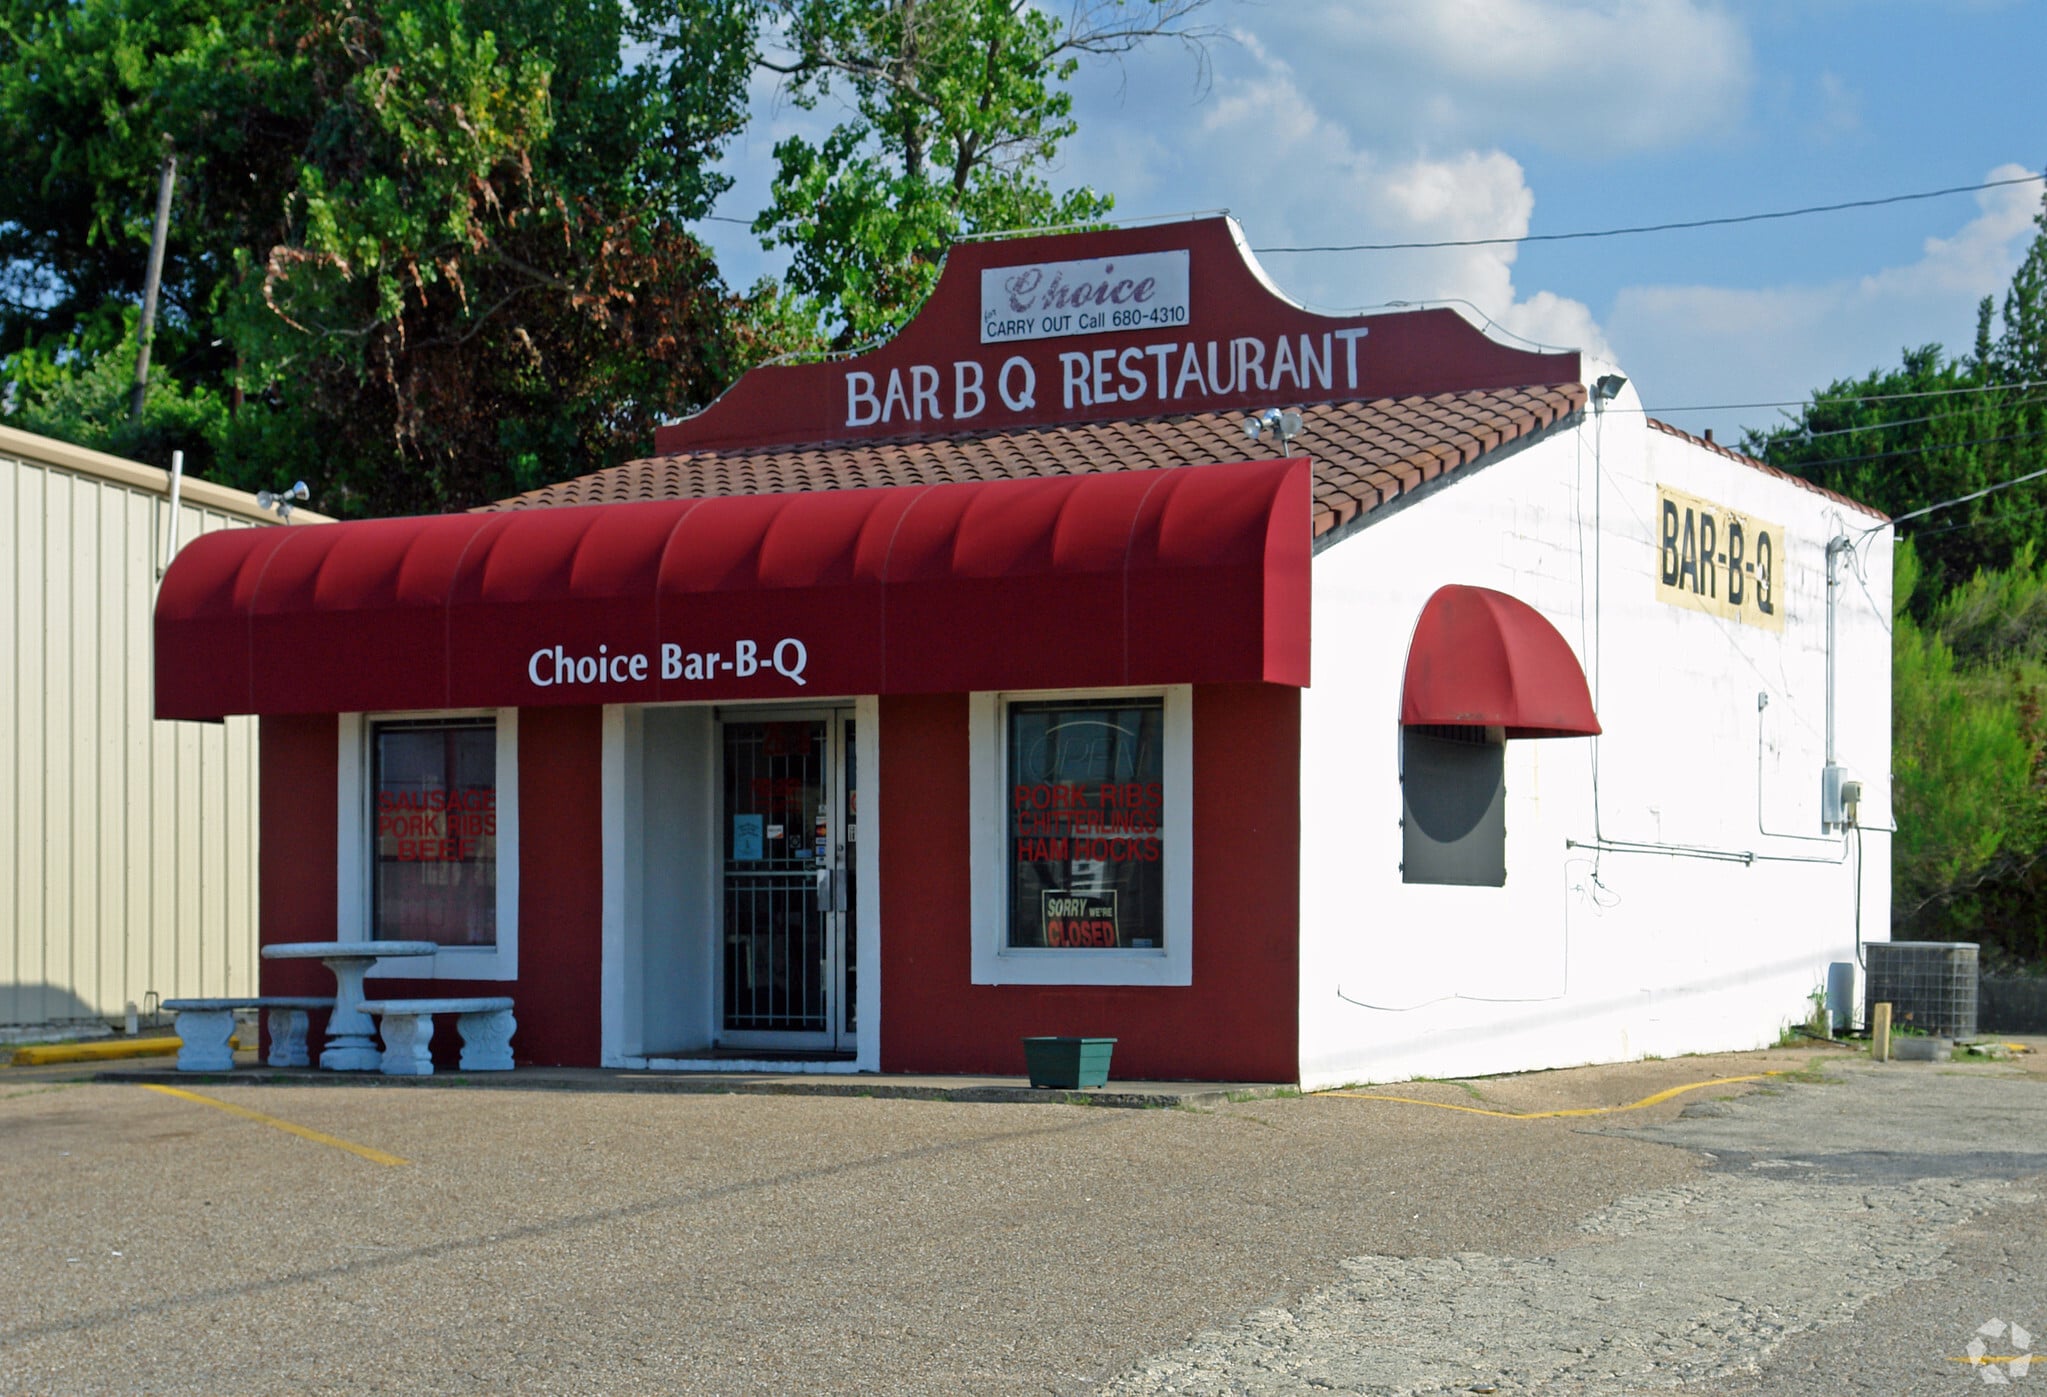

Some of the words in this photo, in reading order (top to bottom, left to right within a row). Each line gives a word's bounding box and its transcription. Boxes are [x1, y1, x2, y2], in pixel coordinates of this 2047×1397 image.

[1005, 263, 1156, 313] Choice
[987, 318, 1035, 338] CARRY
[1042, 315, 1072, 332] OUT
[1079, 312, 1105, 329] Call
[1112, 305, 1185, 327] 680-4310
[845, 364, 944, 428] BAR
[998, 355, 1036, 413] Q
[1058, 326, 1369, 409] RESTAURANT
[1662, 497, 1774, 617] BAR-B-Q
[528, 644, 648, 687] Choice
[661, 638, 808, 686] Bar-B-Q
[377, 788, 497, 814] SAUSAGE
[1015, 784, 1089, 810] PORK
[1100, 782, 1163, 809] RIBS
[378, 814, 439, 838] PORK
[447, 813, 497, 837] RIBS
[1018, 809, 1158, 836] CHITTERLINGS
[397, 838, 476, 862] BEEF
[1017, 838, 1069, 862] HAM
[1074, 836, 1161, 862] HOCKS
[1047, 898, 1088, 918] SORRY
[1089, 906, 1113, 918] WE'RE
[1049, 919, 1115, 947] CLOSED
